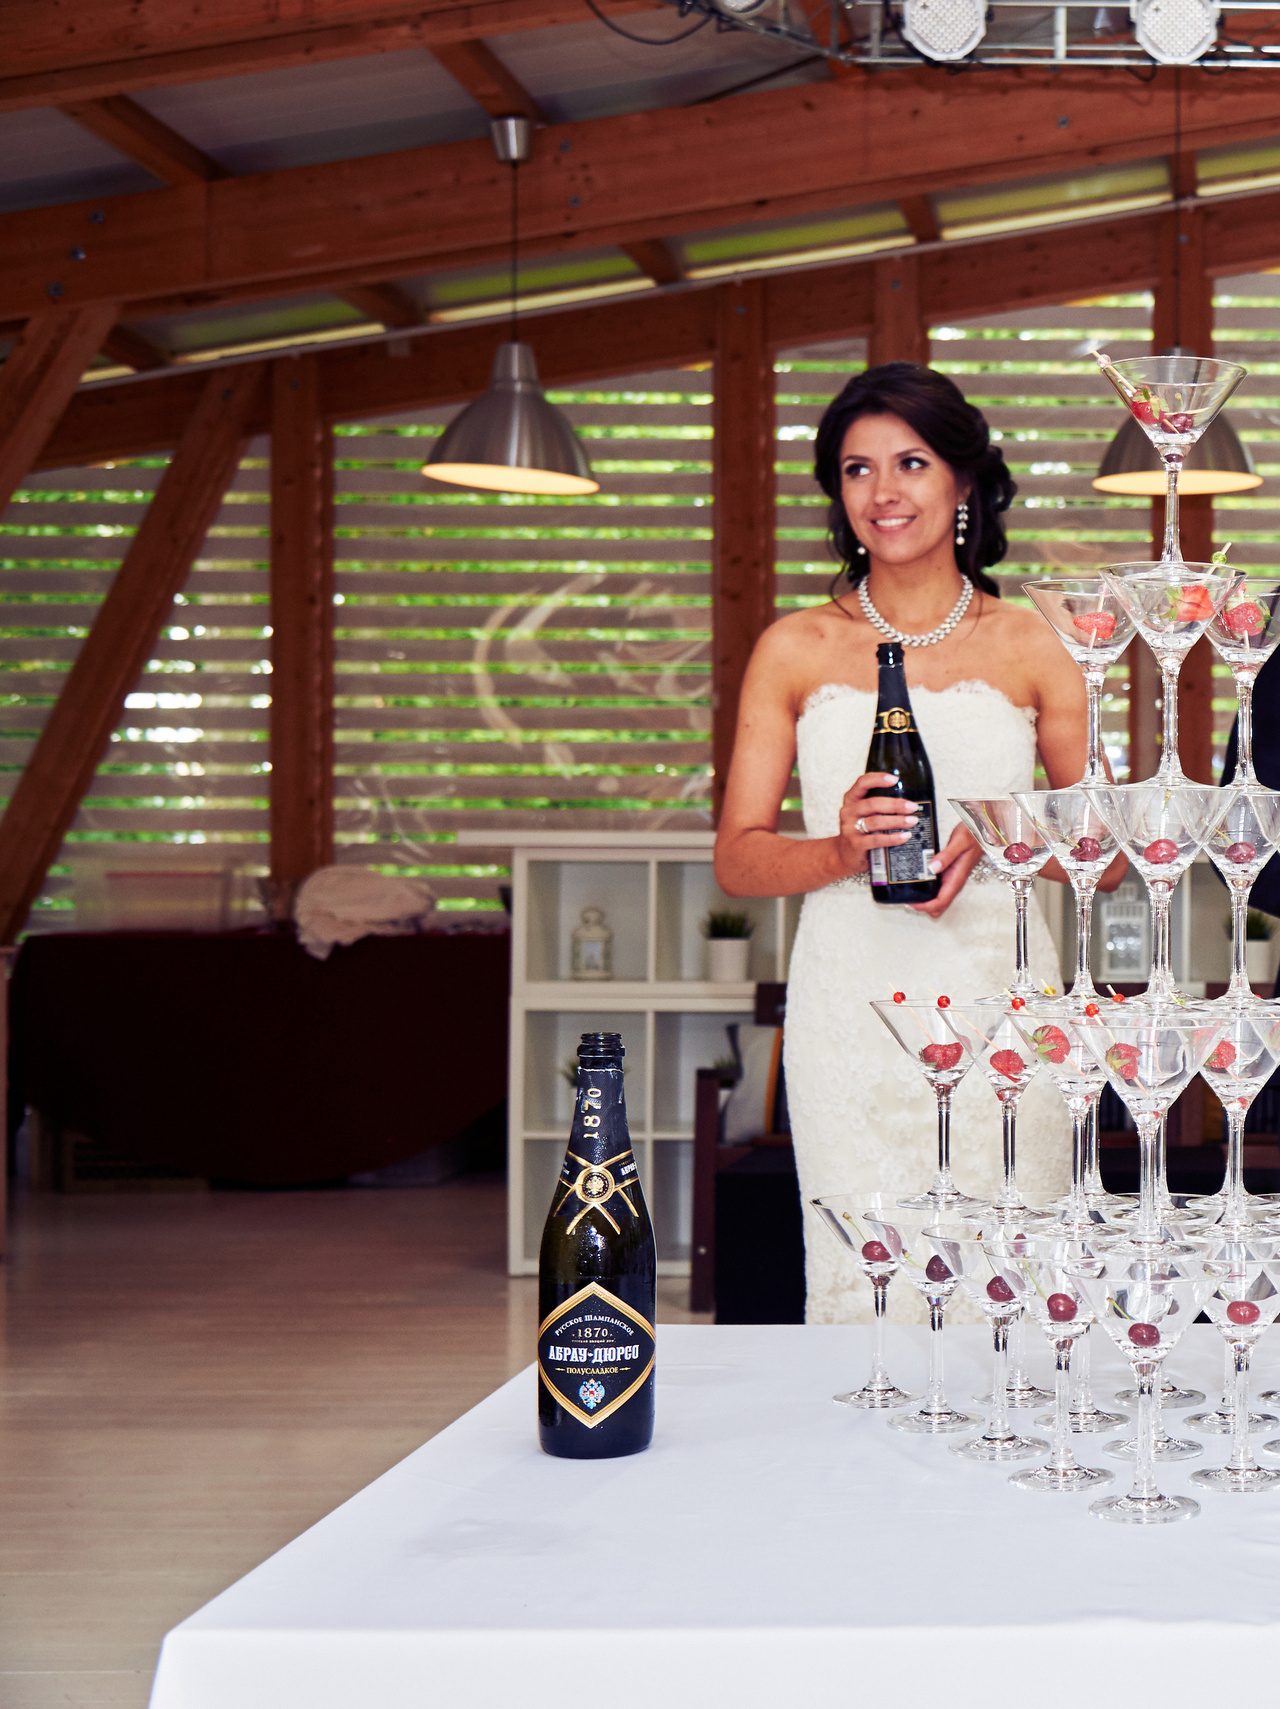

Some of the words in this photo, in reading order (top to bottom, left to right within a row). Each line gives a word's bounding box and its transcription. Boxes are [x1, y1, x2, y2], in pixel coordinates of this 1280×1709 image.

[583, 1087, 602, 1139] 1870
[554, 1316, 583, 1337] РУССКОЕ
[584, 1314, 635, 1336] ШАМПАНСКОЕ
[577, 1327, 609, 1338] 1870
[548, 1344, 640, 1364] АБРАУ-ДЮРСО
[566, 1366, 619, 1375] ПОЛУСЛАДКОЕ
